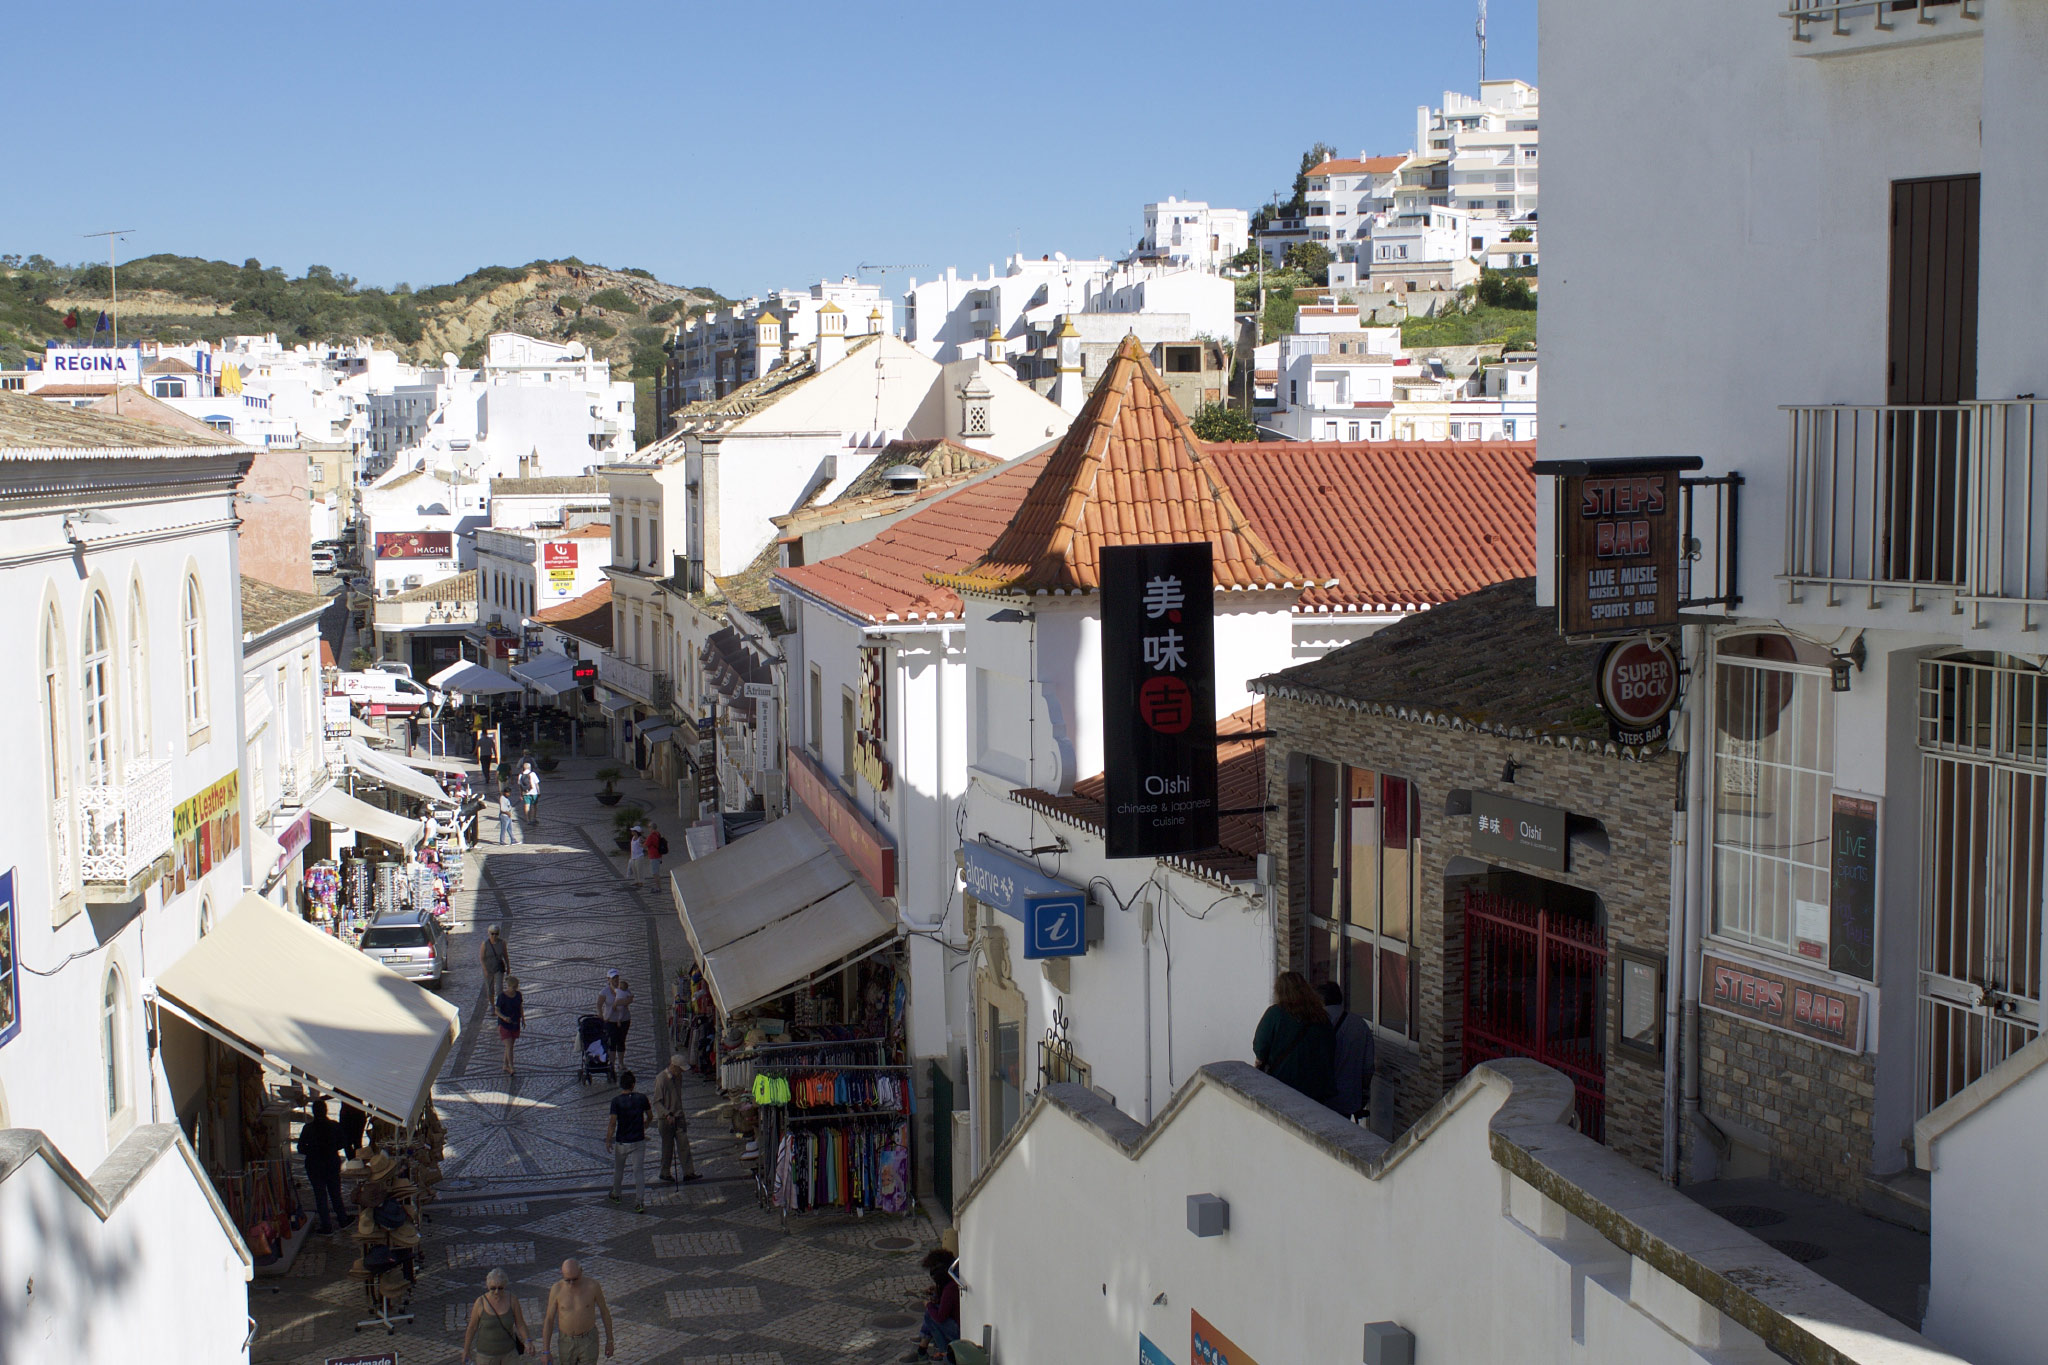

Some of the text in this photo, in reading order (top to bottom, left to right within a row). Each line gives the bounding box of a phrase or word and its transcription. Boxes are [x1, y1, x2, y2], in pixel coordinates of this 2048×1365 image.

[55, 356, 127, 371] REGINA
[1582, 476, 1664, 515] STEPS
[1597, 520, 1650, 557] BAR
[1589, 566, 1657, 587] LIVE MUSIC
[1589, 583, 1657, 599] MUSICA AO VIVO
[1592, 600, 1655, 619] SPORTS BAR
[1617, 661, 1668, 683] SUPER
[746, 686, 771, 696] Atrium
[1621, 678, 1667, 700] BOCK
[1618, 725, 1662, 745] STEPS BAR
[1145, 775, 1190, 796] Oishi
[193, 798, 198, 826] &
[199, 779, 227, 822] Leather
[1117, 798, 1211, 814] chinese & japanese
[1152, 816, 1185, 827] cuisine
[1520, 821, 1542, 840] Oishi
[966, 855, 999, 897] algarve
[1714, 966, 1845, 1035] STEPS BAR
